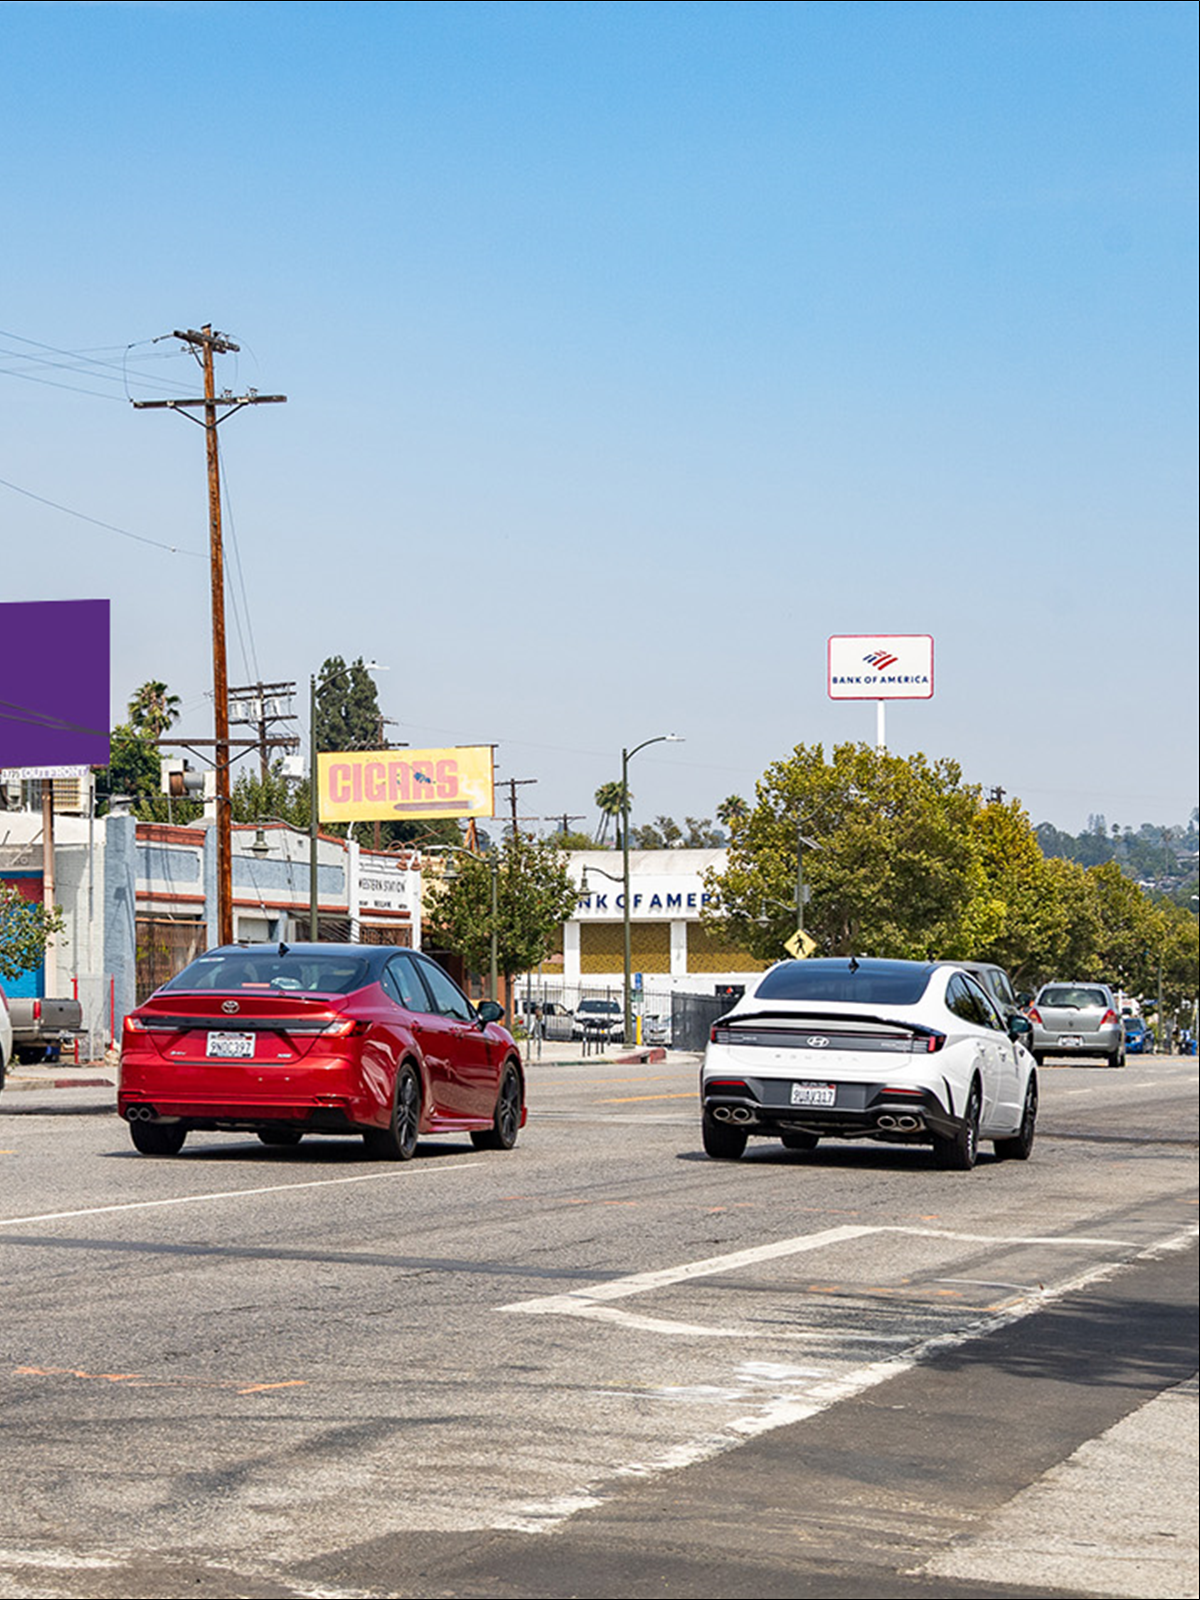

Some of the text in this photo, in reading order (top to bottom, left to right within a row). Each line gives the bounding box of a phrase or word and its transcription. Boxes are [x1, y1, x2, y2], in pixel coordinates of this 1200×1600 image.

[832, 675, 928, 684] BANK OF AMERICA
[328, 759, 459, 803] CIGARS
